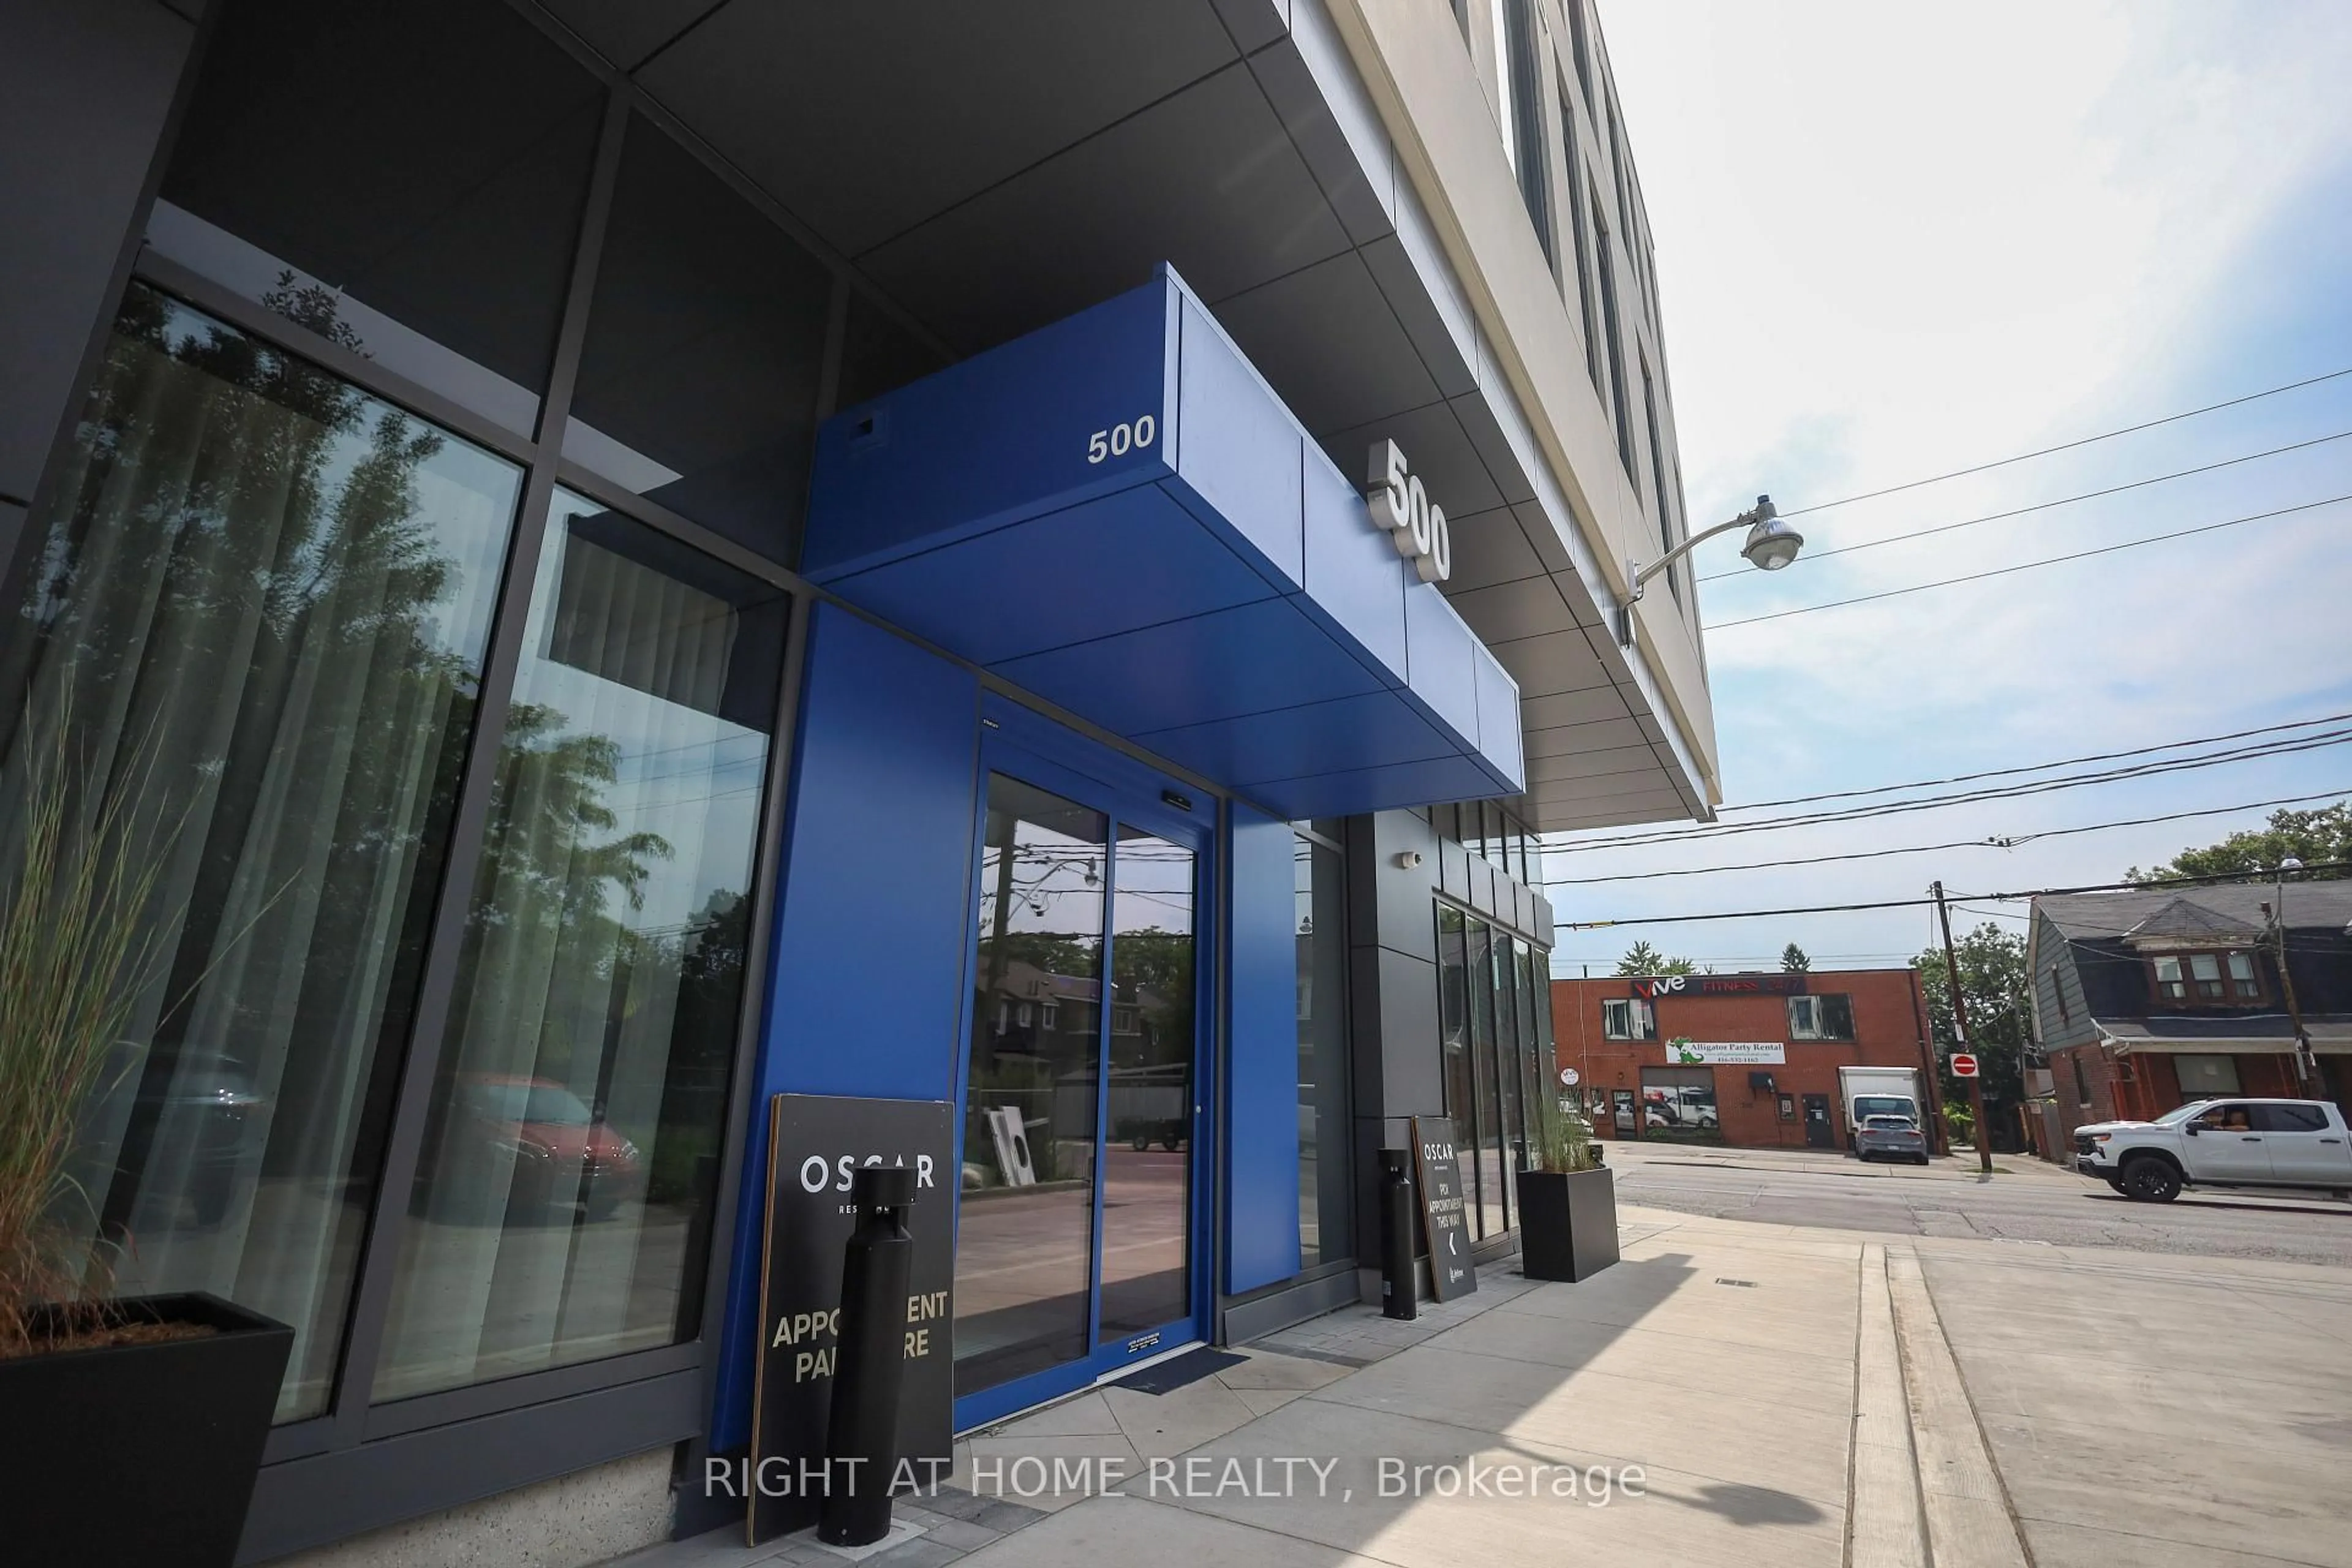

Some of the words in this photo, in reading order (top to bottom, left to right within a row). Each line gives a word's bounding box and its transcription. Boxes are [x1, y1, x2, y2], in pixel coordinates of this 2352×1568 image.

[1087, 415, 1155, 464] 500
[1384, 437, 1450, 581] 500
[1703, 980, 1758, 991] FITNESS
[1691, 1043, 1727, 1052] Alligator
[1730, 1043, 1751, 1052] Party
[1754, 1042, 1781, 1051] Rental
[1424, 1143, 1454, 1161] OSCAR
